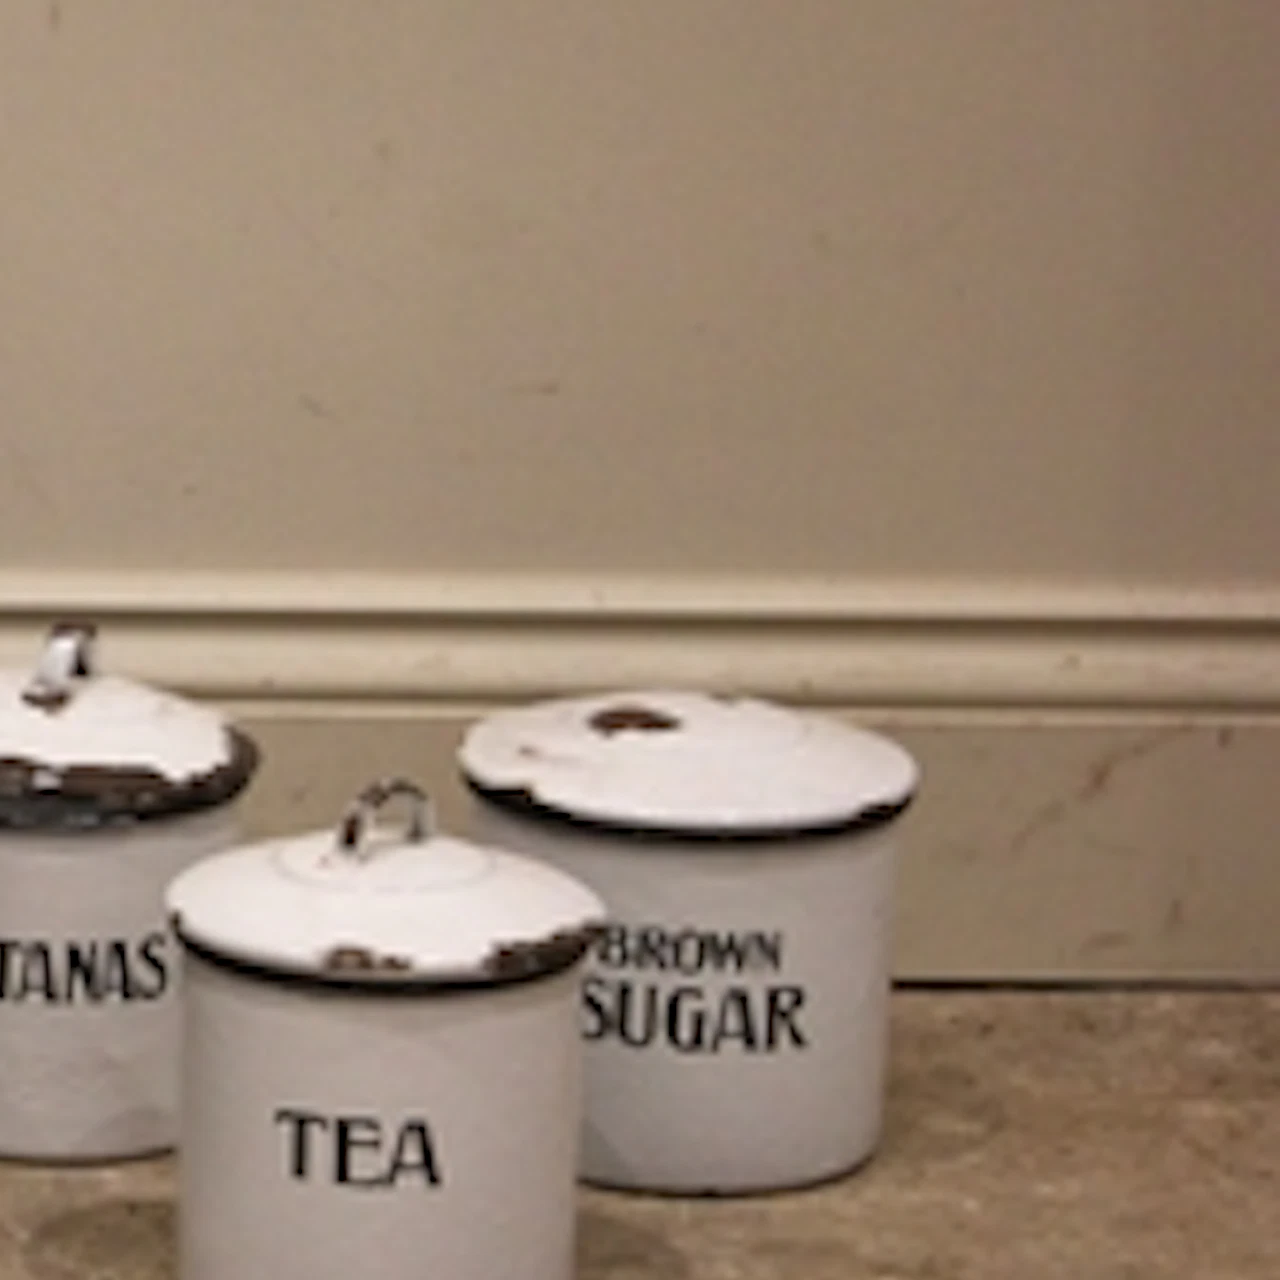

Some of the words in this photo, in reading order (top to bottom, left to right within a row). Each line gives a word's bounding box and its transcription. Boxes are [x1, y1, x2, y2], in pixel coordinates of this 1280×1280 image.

[594, 923, 782, 976] BROWN
[580, 976, 808, 1054] SUGAR
[273, 1108, 443, 1188] TEA
